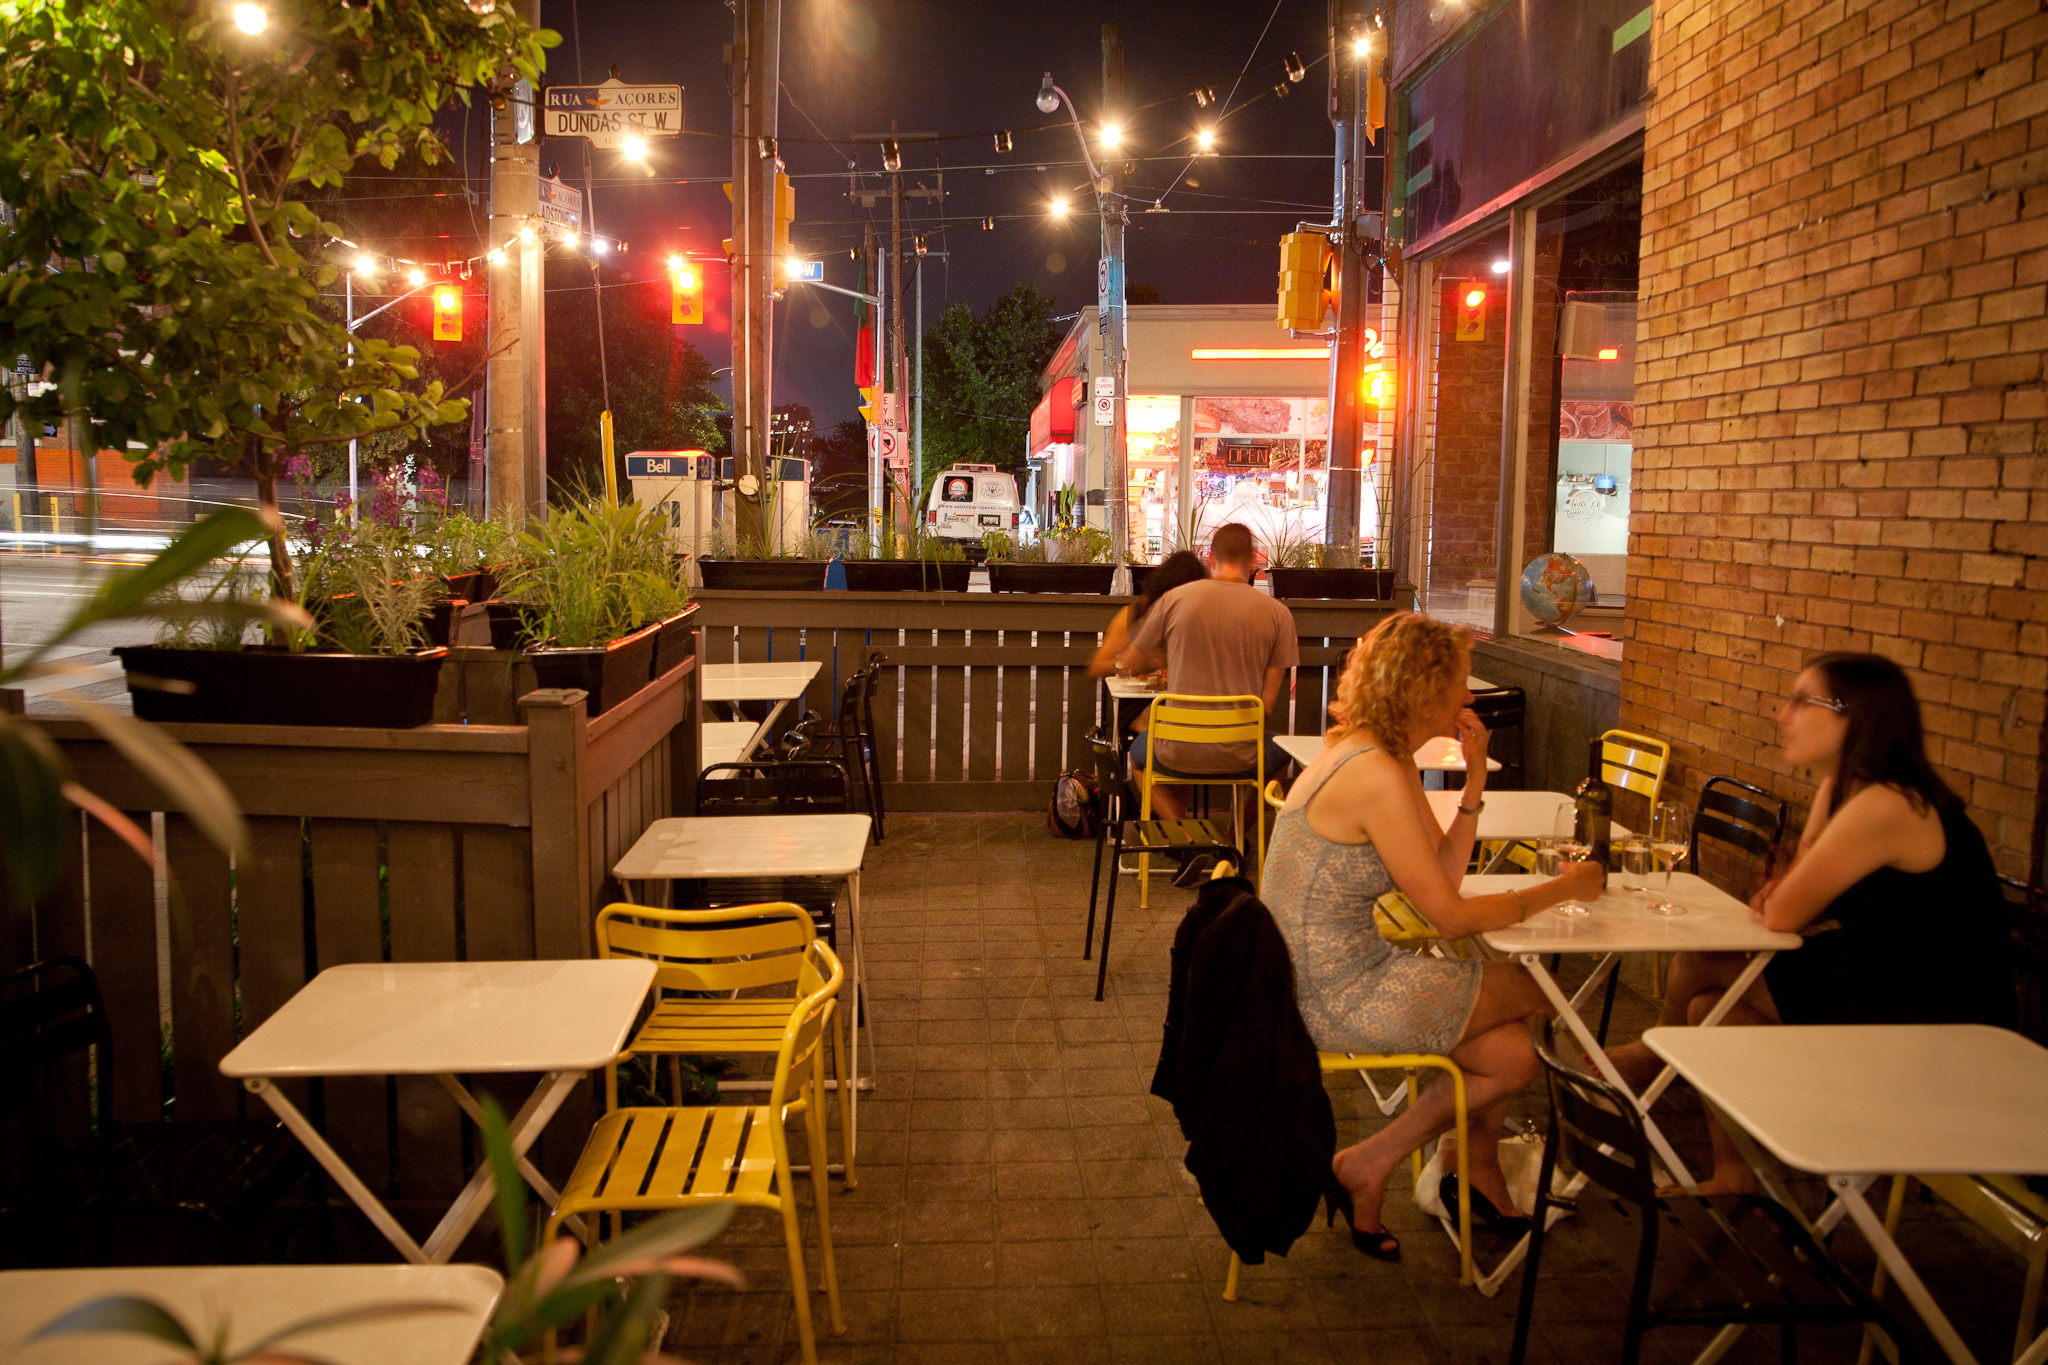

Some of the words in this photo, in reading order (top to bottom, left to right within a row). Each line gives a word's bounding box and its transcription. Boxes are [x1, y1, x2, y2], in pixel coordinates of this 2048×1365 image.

[550, 93, 582, 106] RUA
[615, 92, 676, 107] AÇORES
[558, 112, 622, 132] DUNDAS
[654, 112, 668, 131] W
[541, 204, 570, 228] ADSTONE
[1228, 448, 1268, 463] OPEN
[646, 458, 671, 473] Bell
[765, 459, 781, 480] ell
